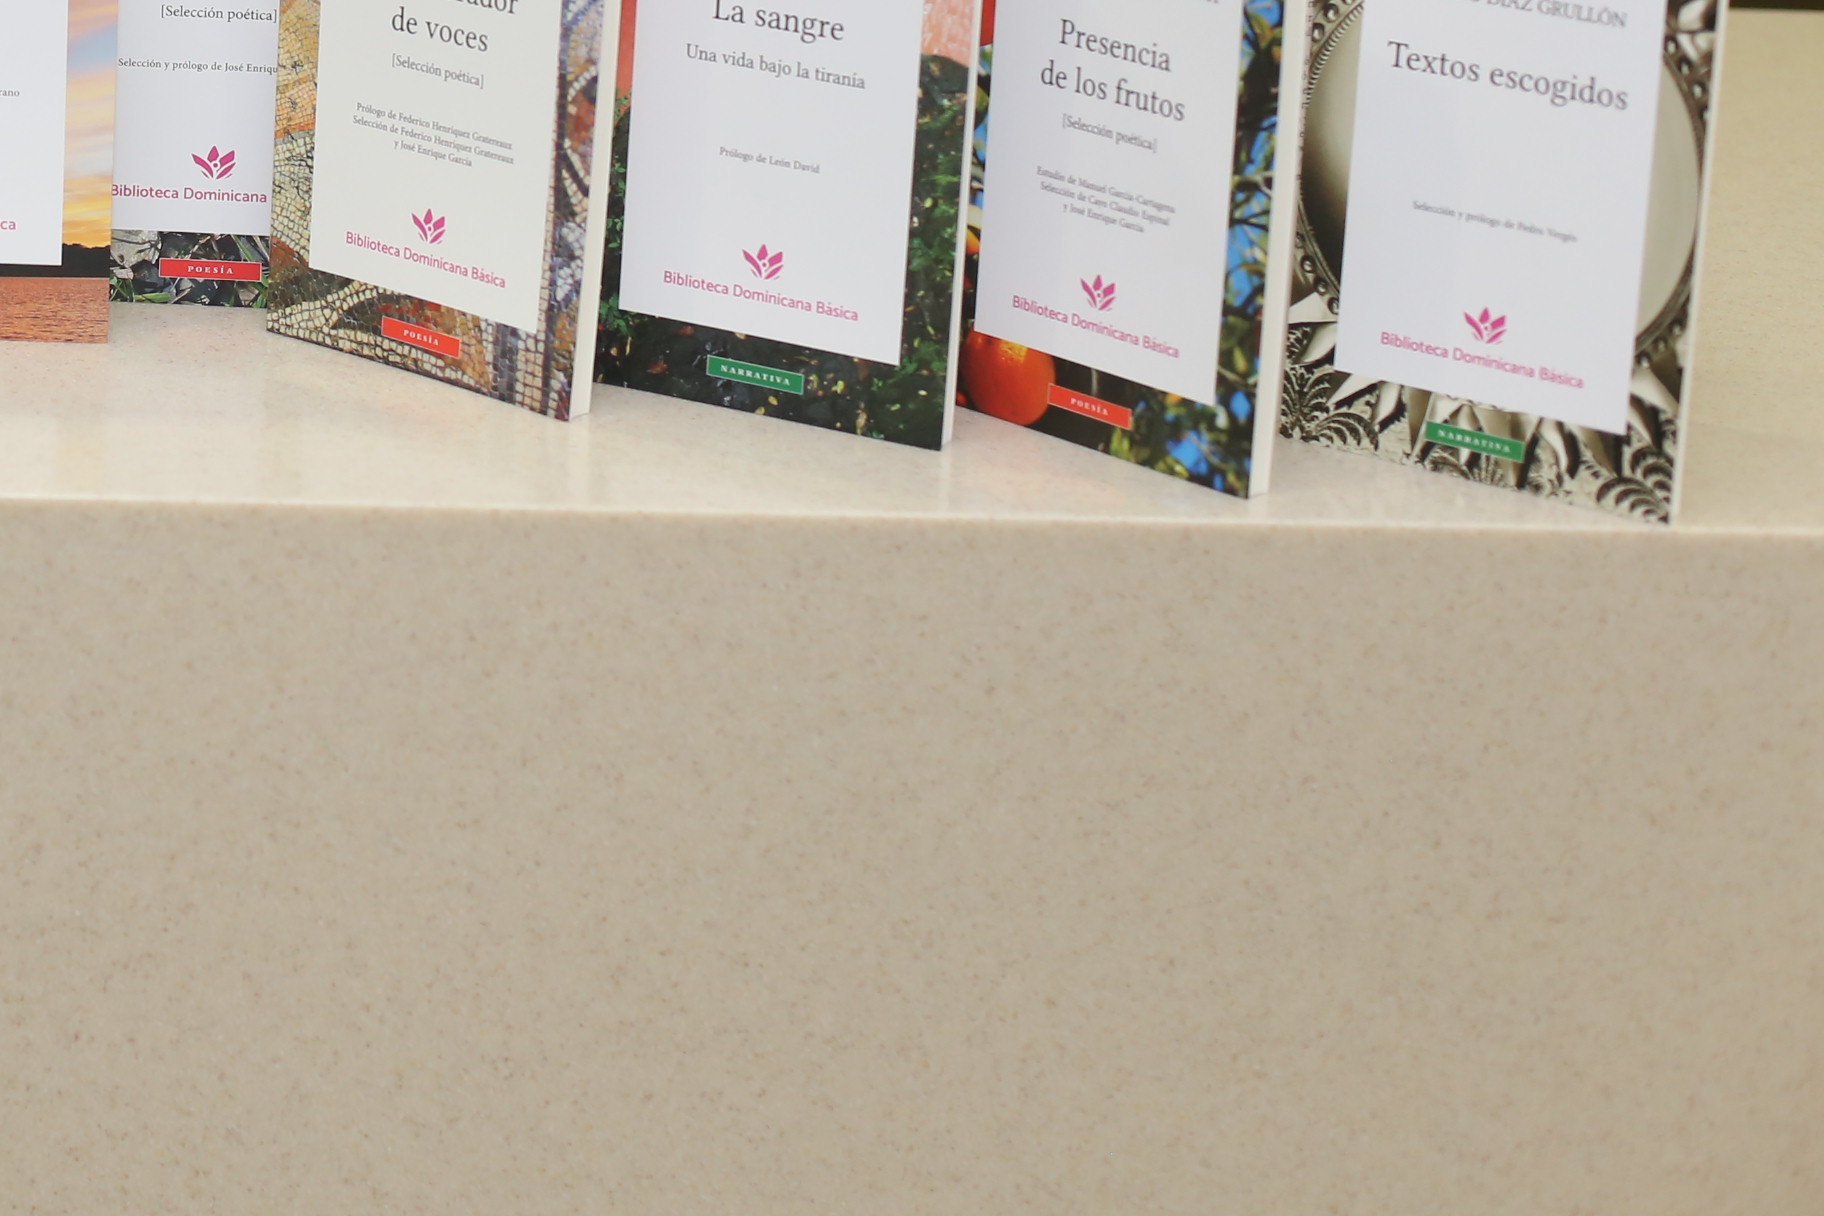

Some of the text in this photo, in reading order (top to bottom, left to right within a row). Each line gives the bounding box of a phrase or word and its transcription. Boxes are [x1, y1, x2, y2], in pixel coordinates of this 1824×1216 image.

[162, 5, 277, 23] [Selección poética]
[392, 7, 487, 52] de voces
[754, 9, 844, 44] sangre
[118, 57, 161, 69] Selección
[172, 61, 208, 72] prólogo
[210, 61, 221, 71] de
[224, 61, 243, 73] José
[686, 42, 865, 89] Una vida bajo la tiranía
[1058, 18, 1170, 71] Presencia
[392, 53, 484, 89] [Selección poética]
[1040, 59, 1184, 121] de los frutos
[1388, 40, 1627, 110] Textos escogidos
[183, 187, 267, 203] Dominicana
[187, 264, 234, 275] POESÍA
[346, 230, 505, 288] Biblioteca Dominicana Básica
[664, 270, 858, 321] Biblioteca Dominicana Básica
[402, 329, 439, 346] POESÍA
[1012, 294, 1179, 359] Biblioteca Dominicana Básica
[720, 364, 789, 385] NARRATIVA
[1380, 331, 1584, 389] Biblioteca Dominicana Básica
